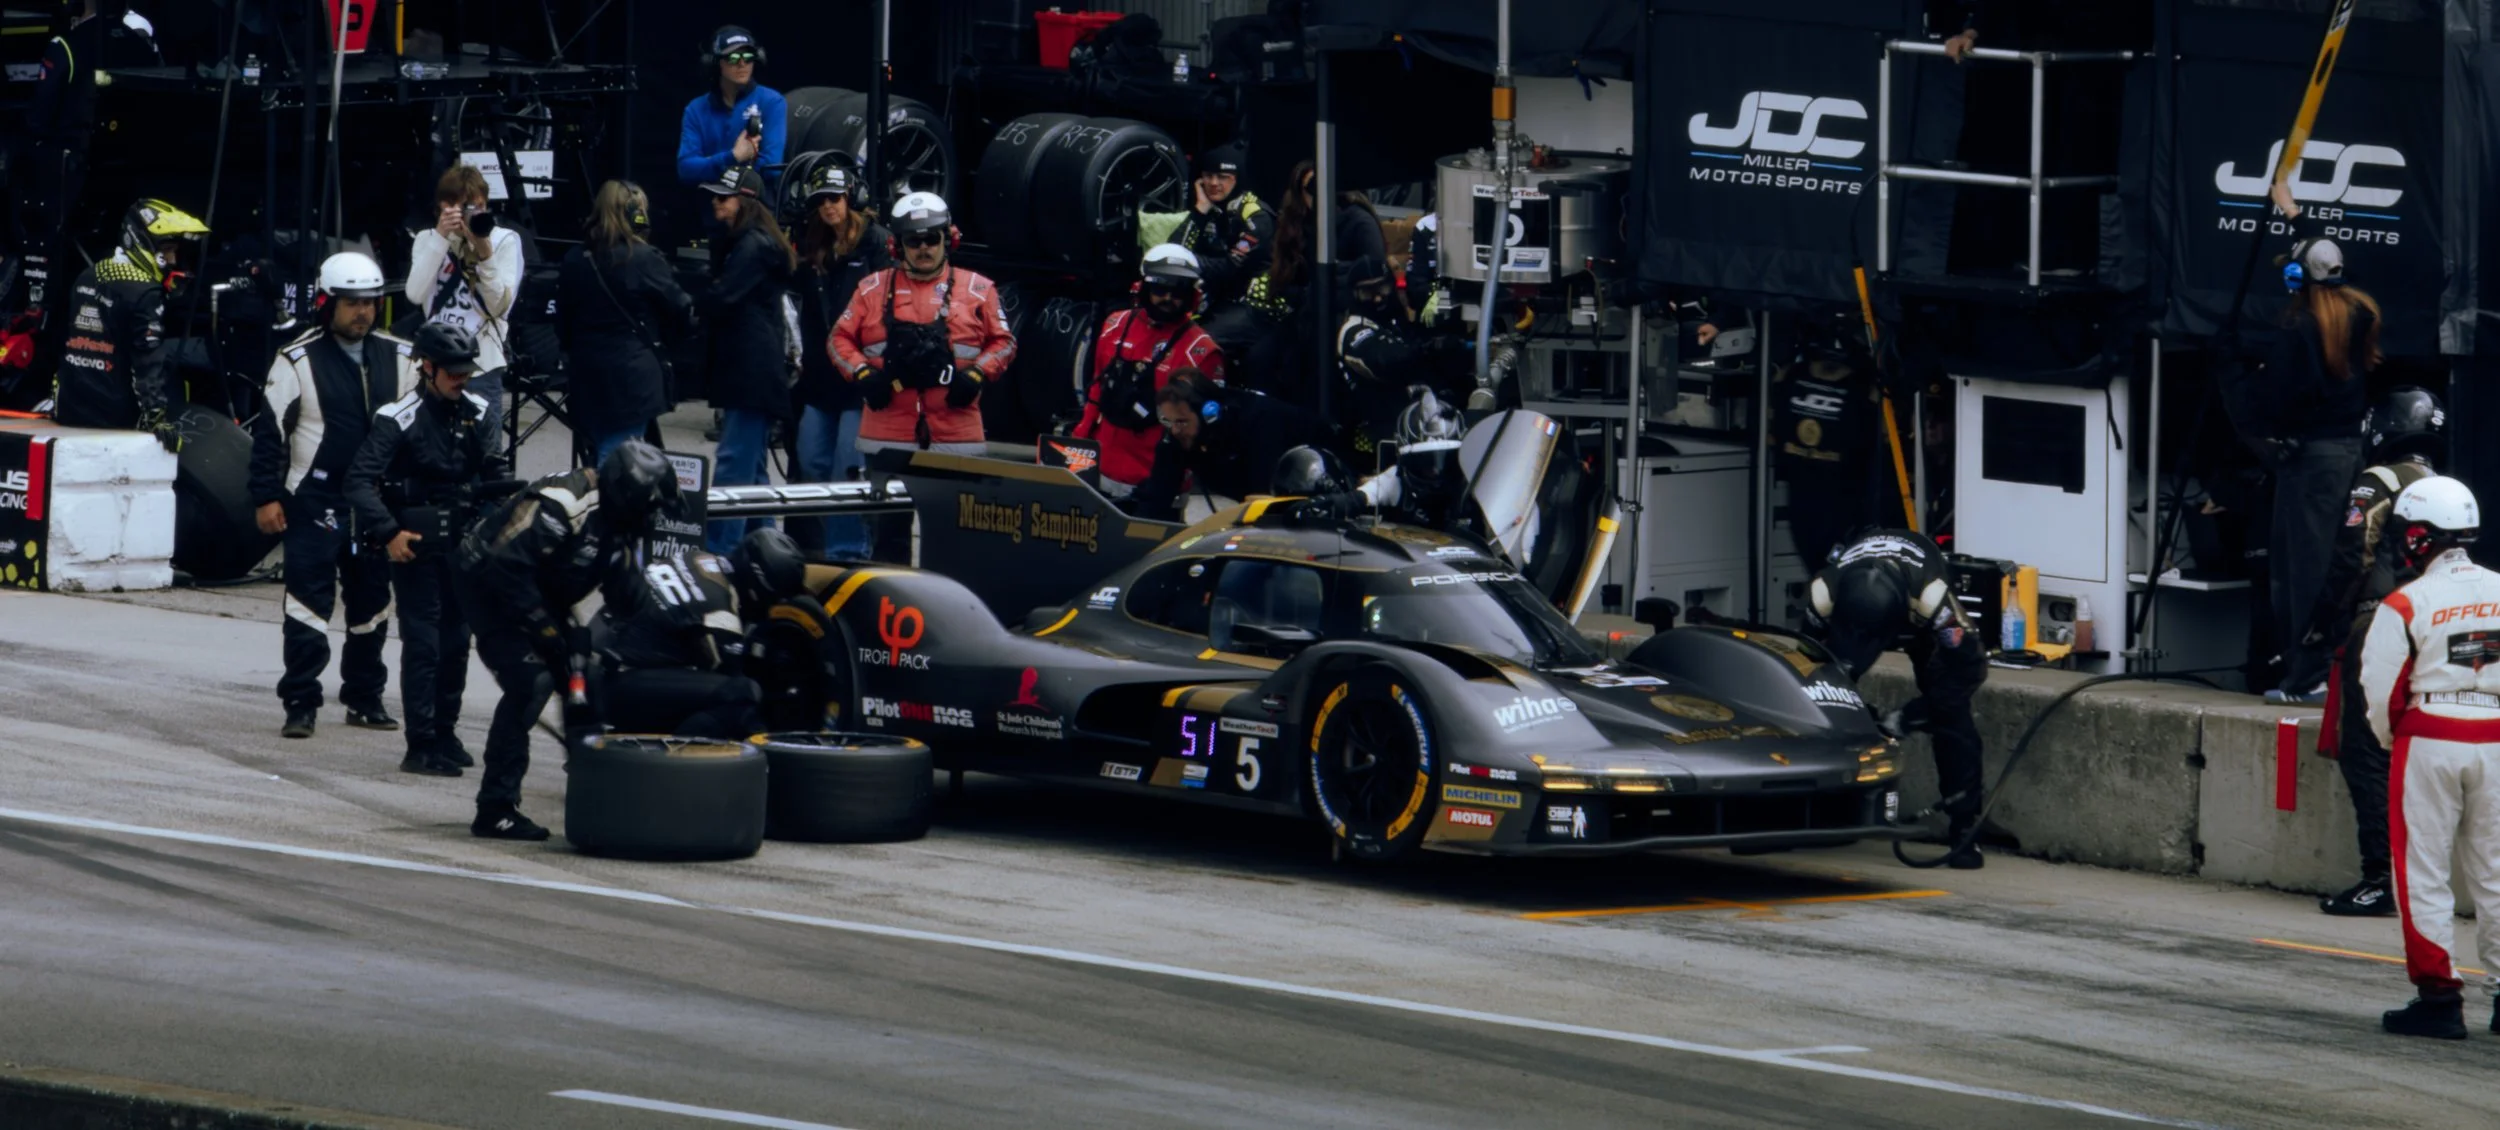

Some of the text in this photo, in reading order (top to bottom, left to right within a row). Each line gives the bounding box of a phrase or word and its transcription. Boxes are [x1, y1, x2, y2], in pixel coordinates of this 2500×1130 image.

[1688, 91, 1868, 159] JDC
[1743, 154, 1810, 172] MILLER
[1689, 167, 1863, 195] MOTORSPORTS
[959, 493, 1099, 553] Mustang Sampling
[900, 652, 930, 671] PACK
[1493, 696, 1559, 727] wiha
[1223, 720, 1278, 736] WeatherTech
[1236, 735, 1261, 791] 5
[1447, 789, 1518, 804] MICHELIN
[1451, 811, 1494, 826] MOTUL
